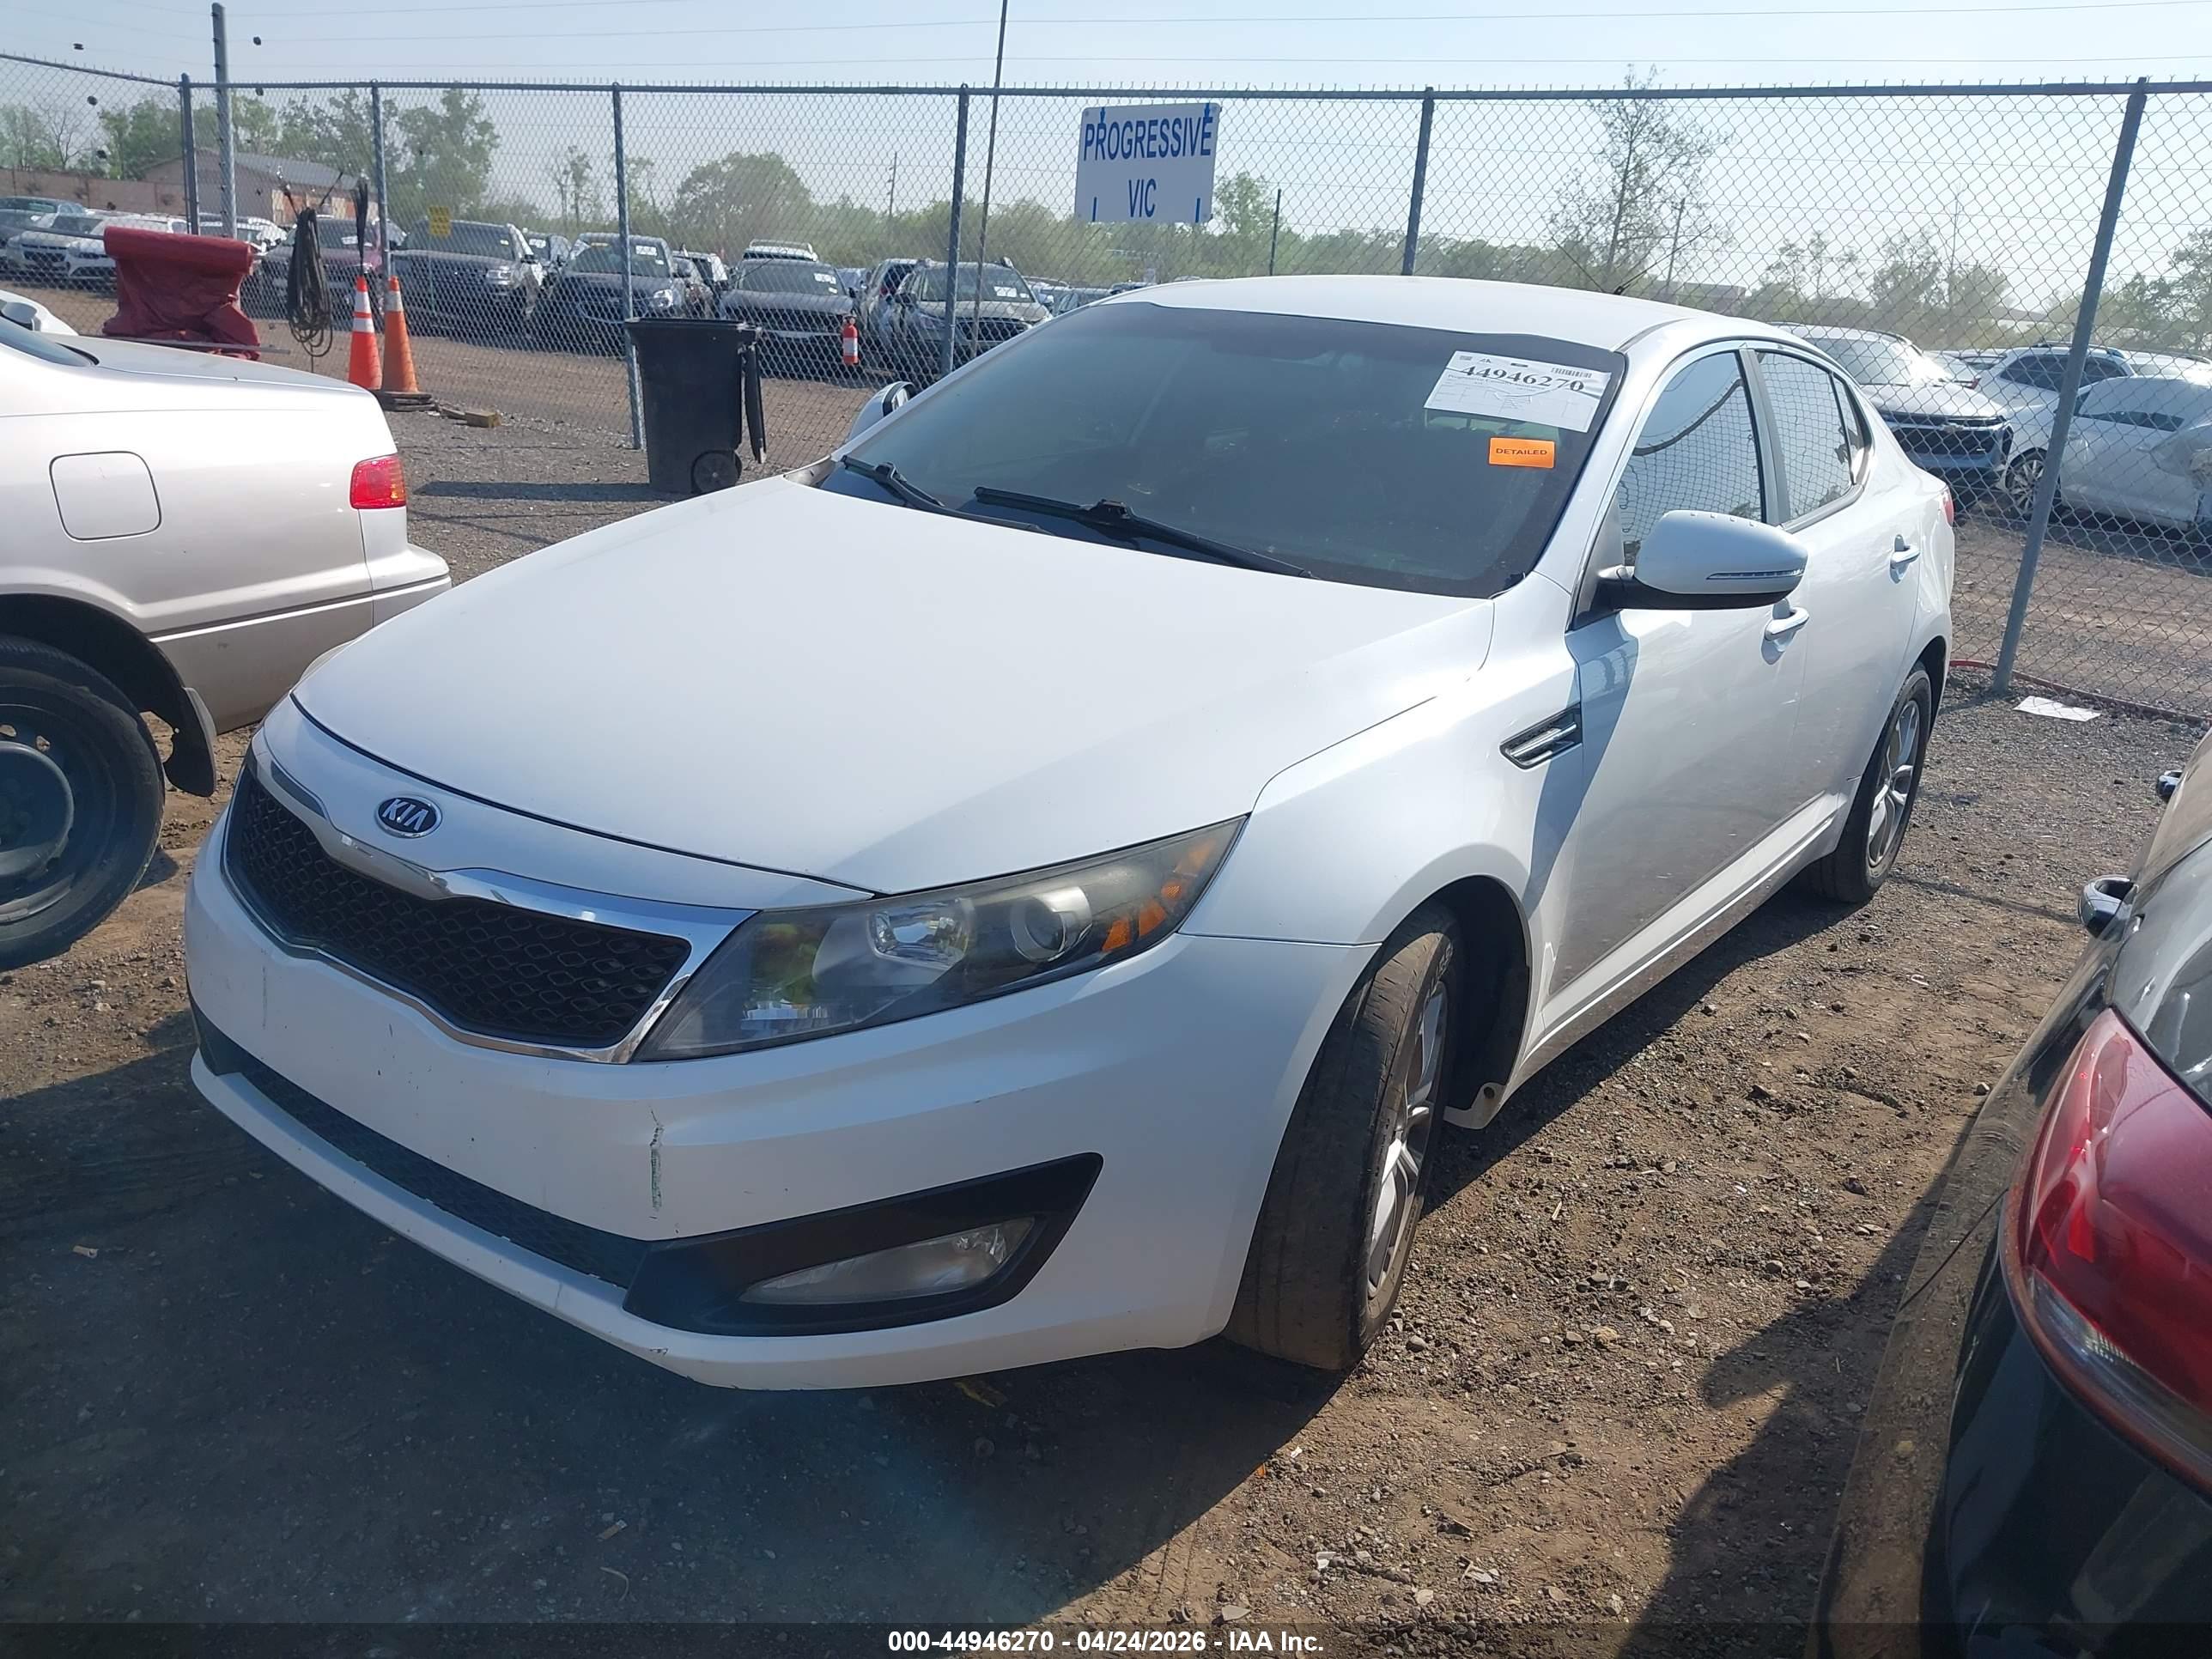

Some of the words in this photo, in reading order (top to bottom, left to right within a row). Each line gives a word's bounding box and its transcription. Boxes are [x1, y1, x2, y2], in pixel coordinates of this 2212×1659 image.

[1084, 116, 1214, 161] PROGRESSIVE
[1128, 178, 1157, 217] VIC
[1462, 366, 1584, 392] 44946270
[382, 798, 429, 831] KIA
